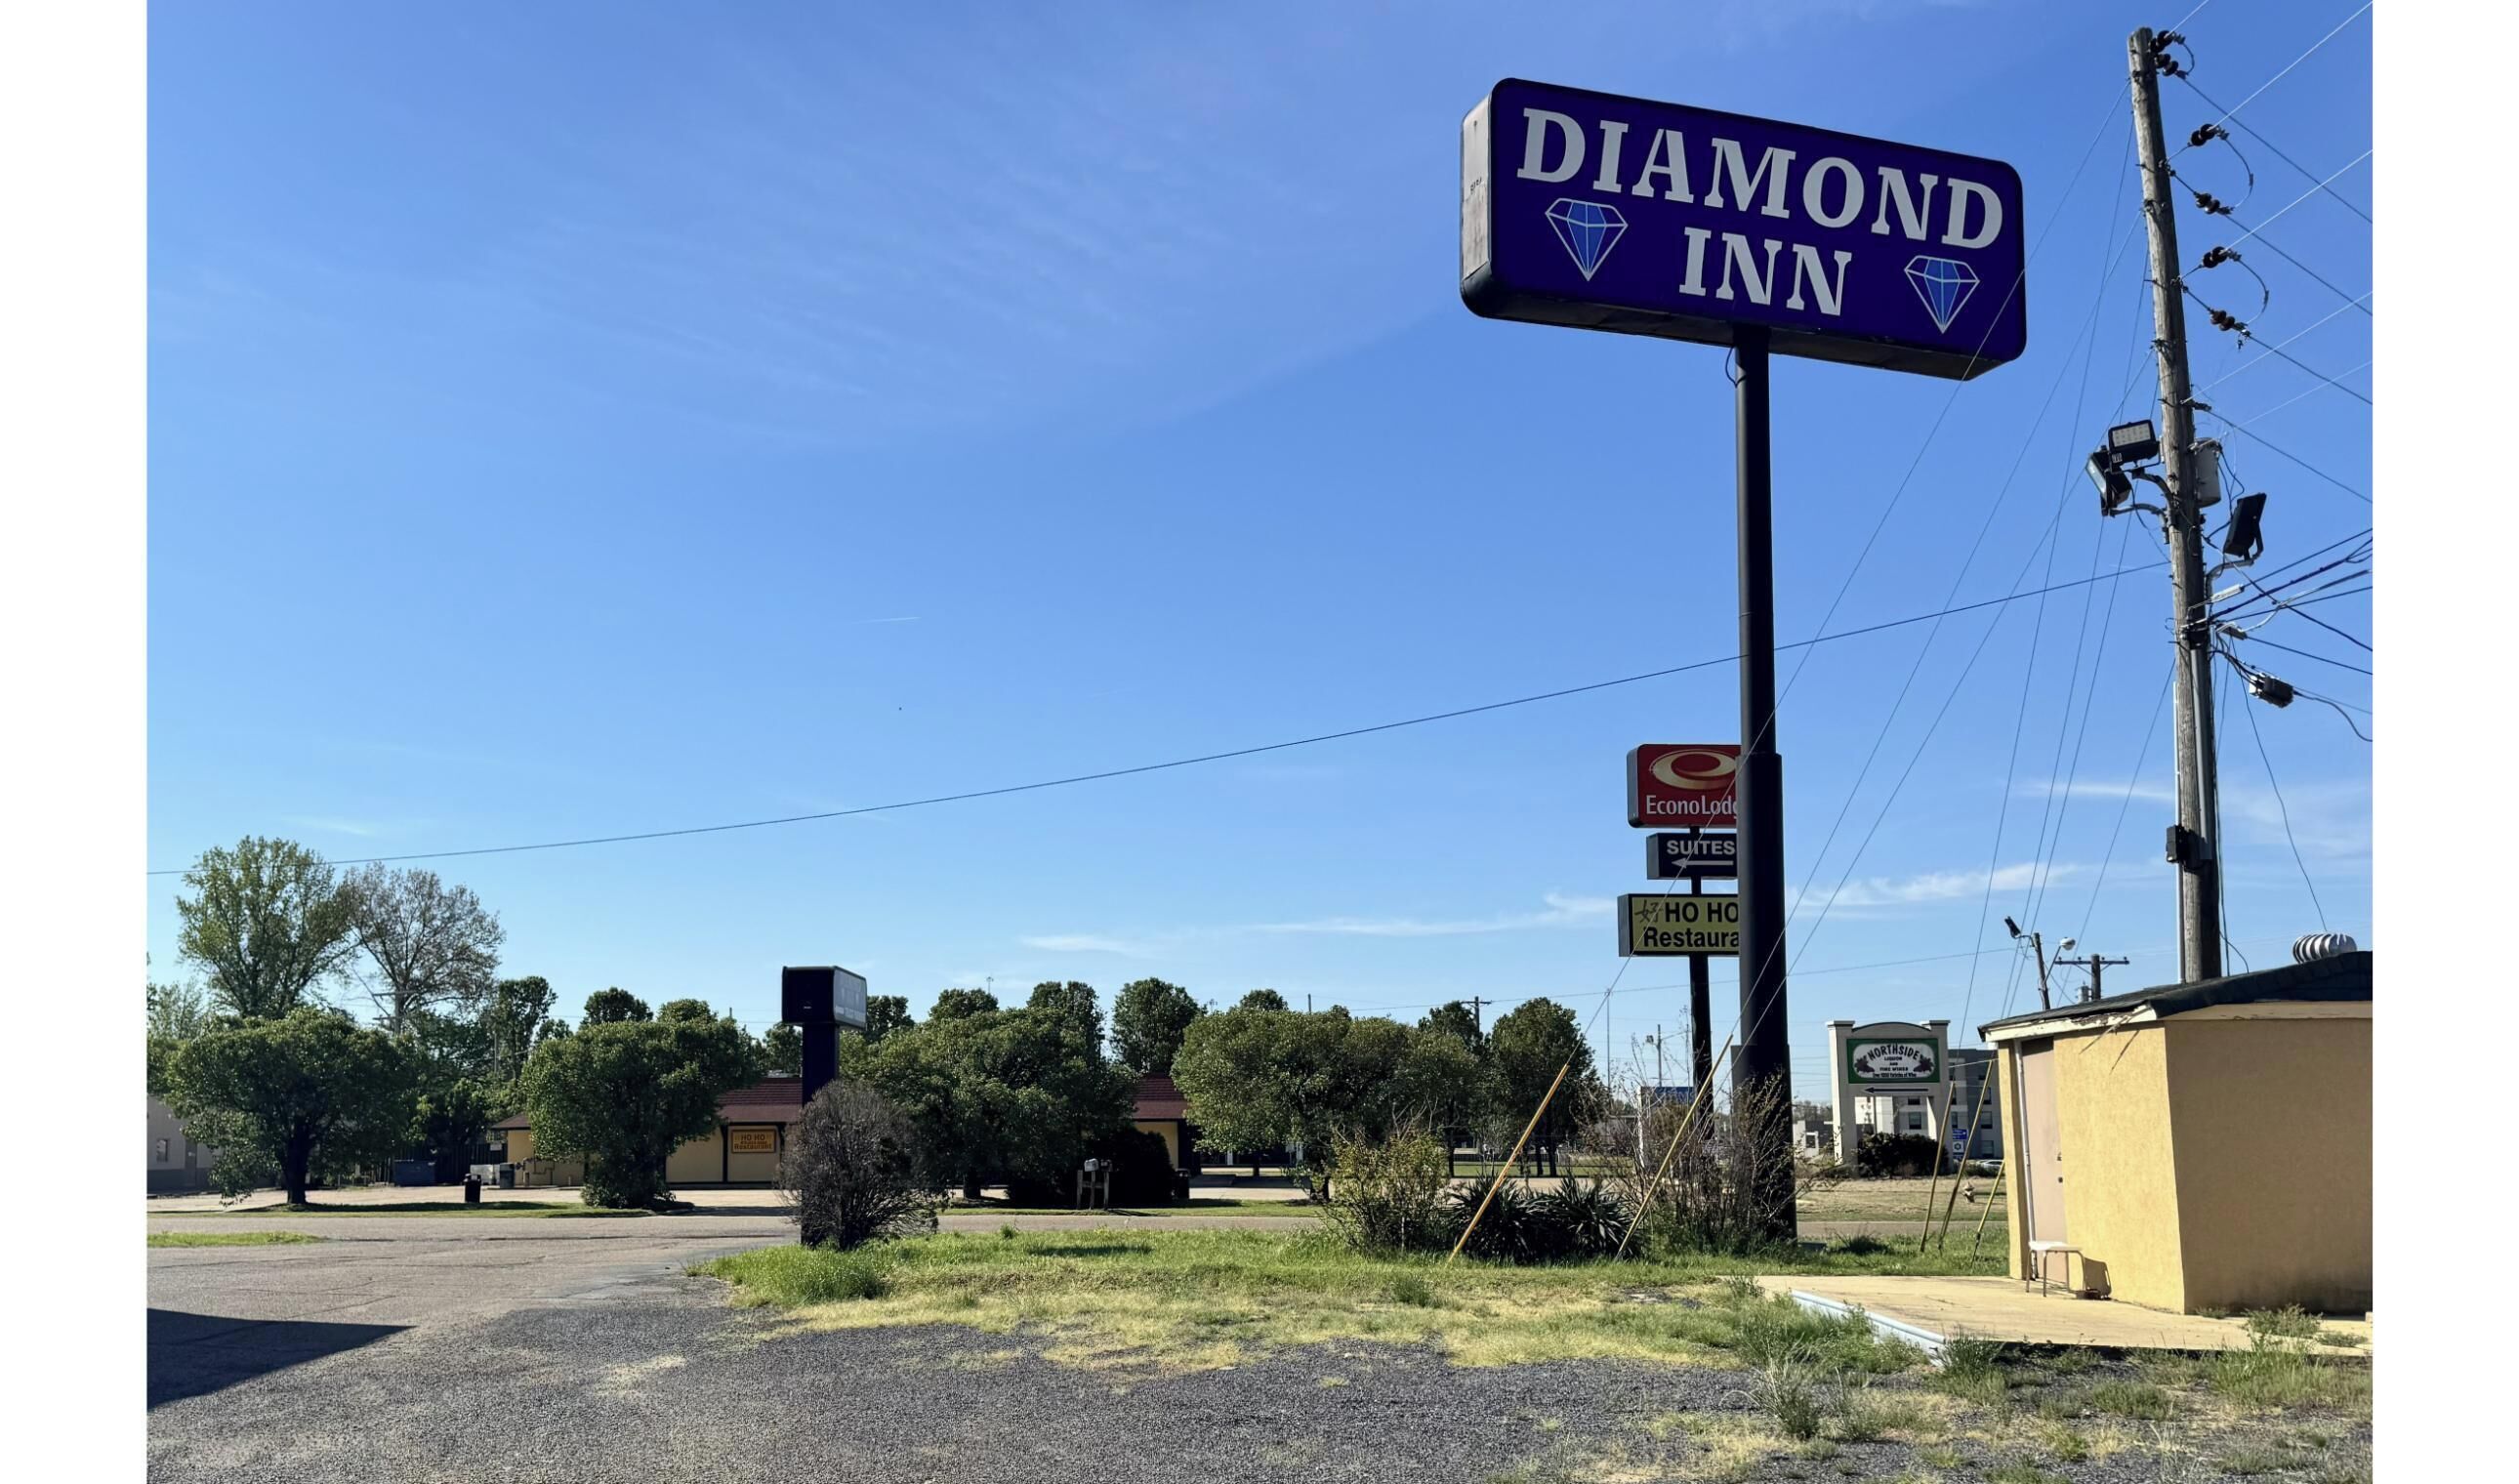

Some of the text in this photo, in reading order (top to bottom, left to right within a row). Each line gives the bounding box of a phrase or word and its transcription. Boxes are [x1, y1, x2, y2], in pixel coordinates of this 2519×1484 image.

[1516, 107, 2003, 250] DIAMOND
[1678, 227, 1852, 317] INN
[1667, 840, 1735, 855] SUITES
[1665, 901, 1739, 923] HO HO
[1644, 927, 1739, 947] Restaura
[1867, 1044, 1920, 1061] NORTHSIDE
